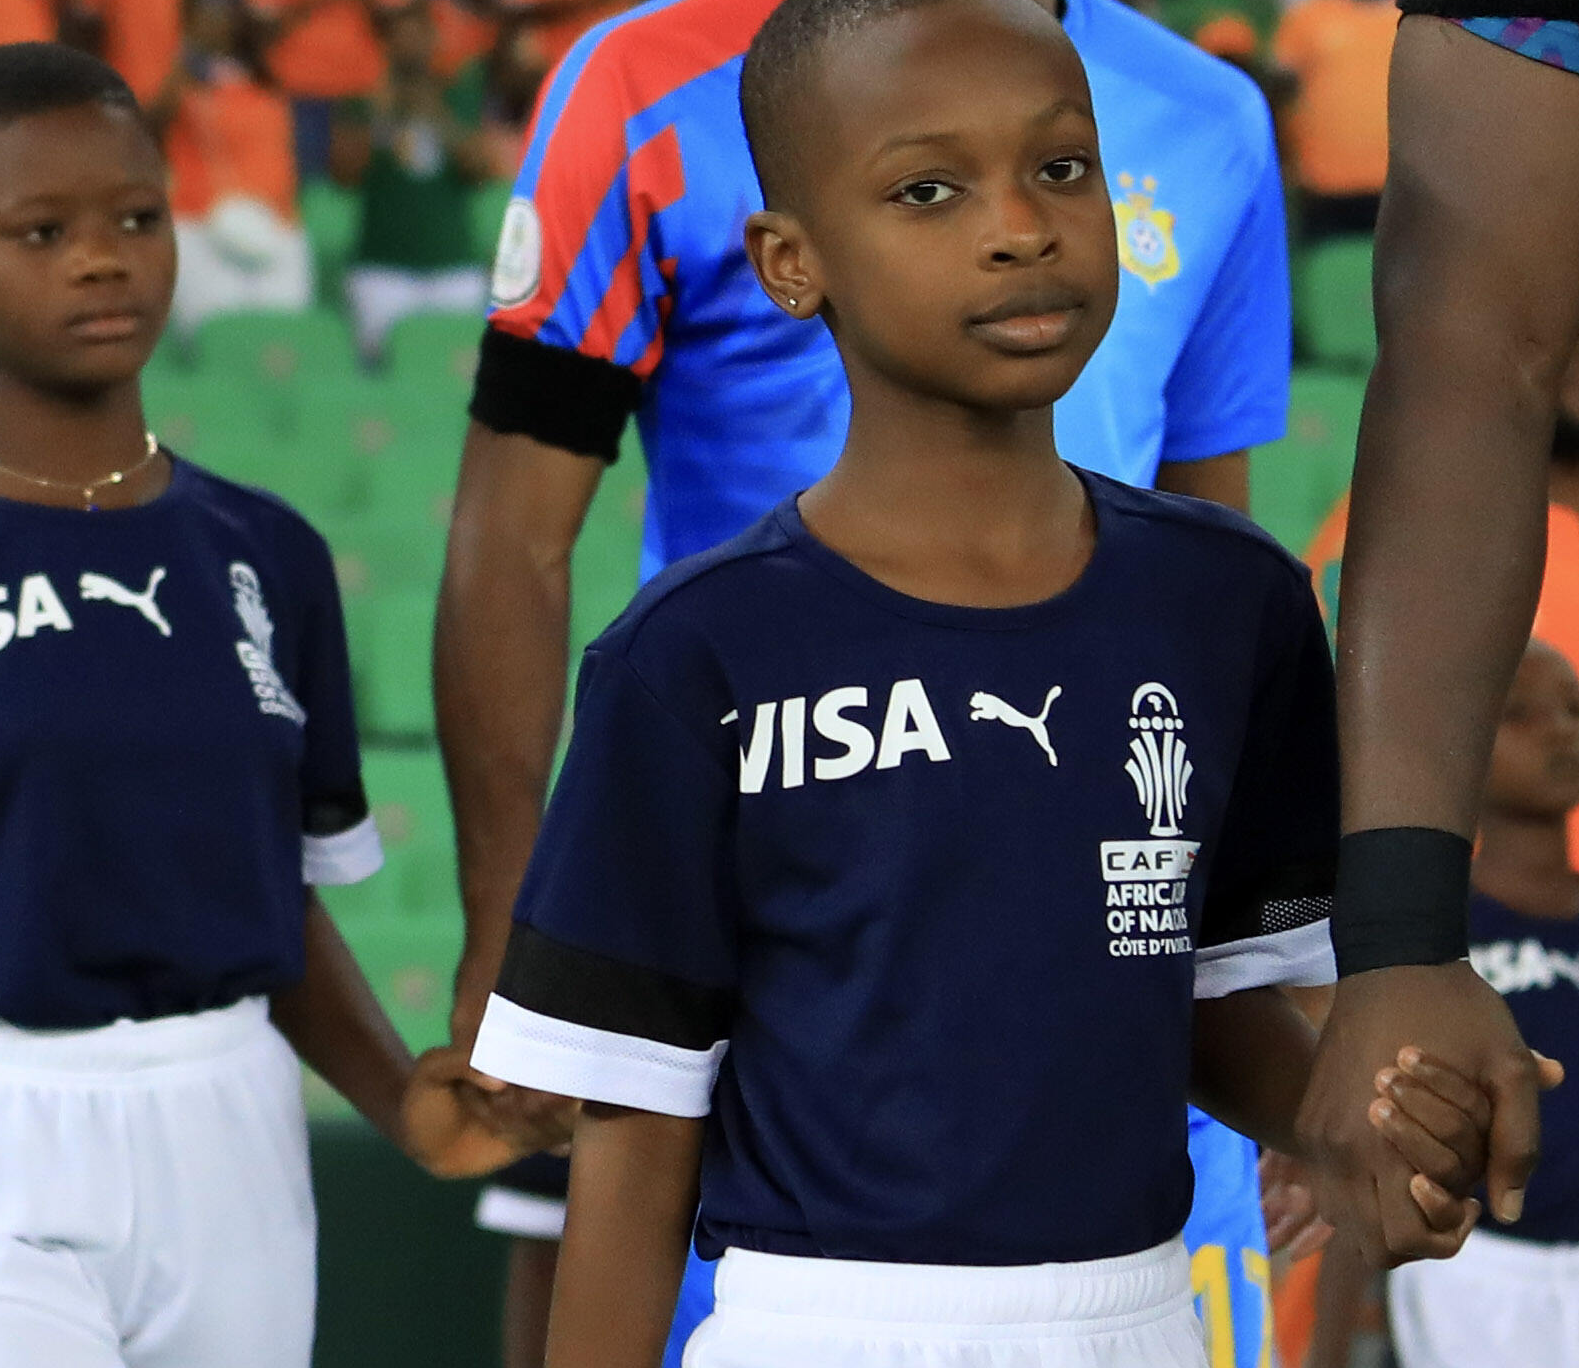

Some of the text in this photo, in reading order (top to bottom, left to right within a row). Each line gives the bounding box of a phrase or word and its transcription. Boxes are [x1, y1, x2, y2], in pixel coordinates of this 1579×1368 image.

[721, 679, 951, 793] VISA
[1106, 850, 1174, 871] CAF
[1107, 909, 1136, 933] OF
[1109, 935, 1147, 957] CÔTE
